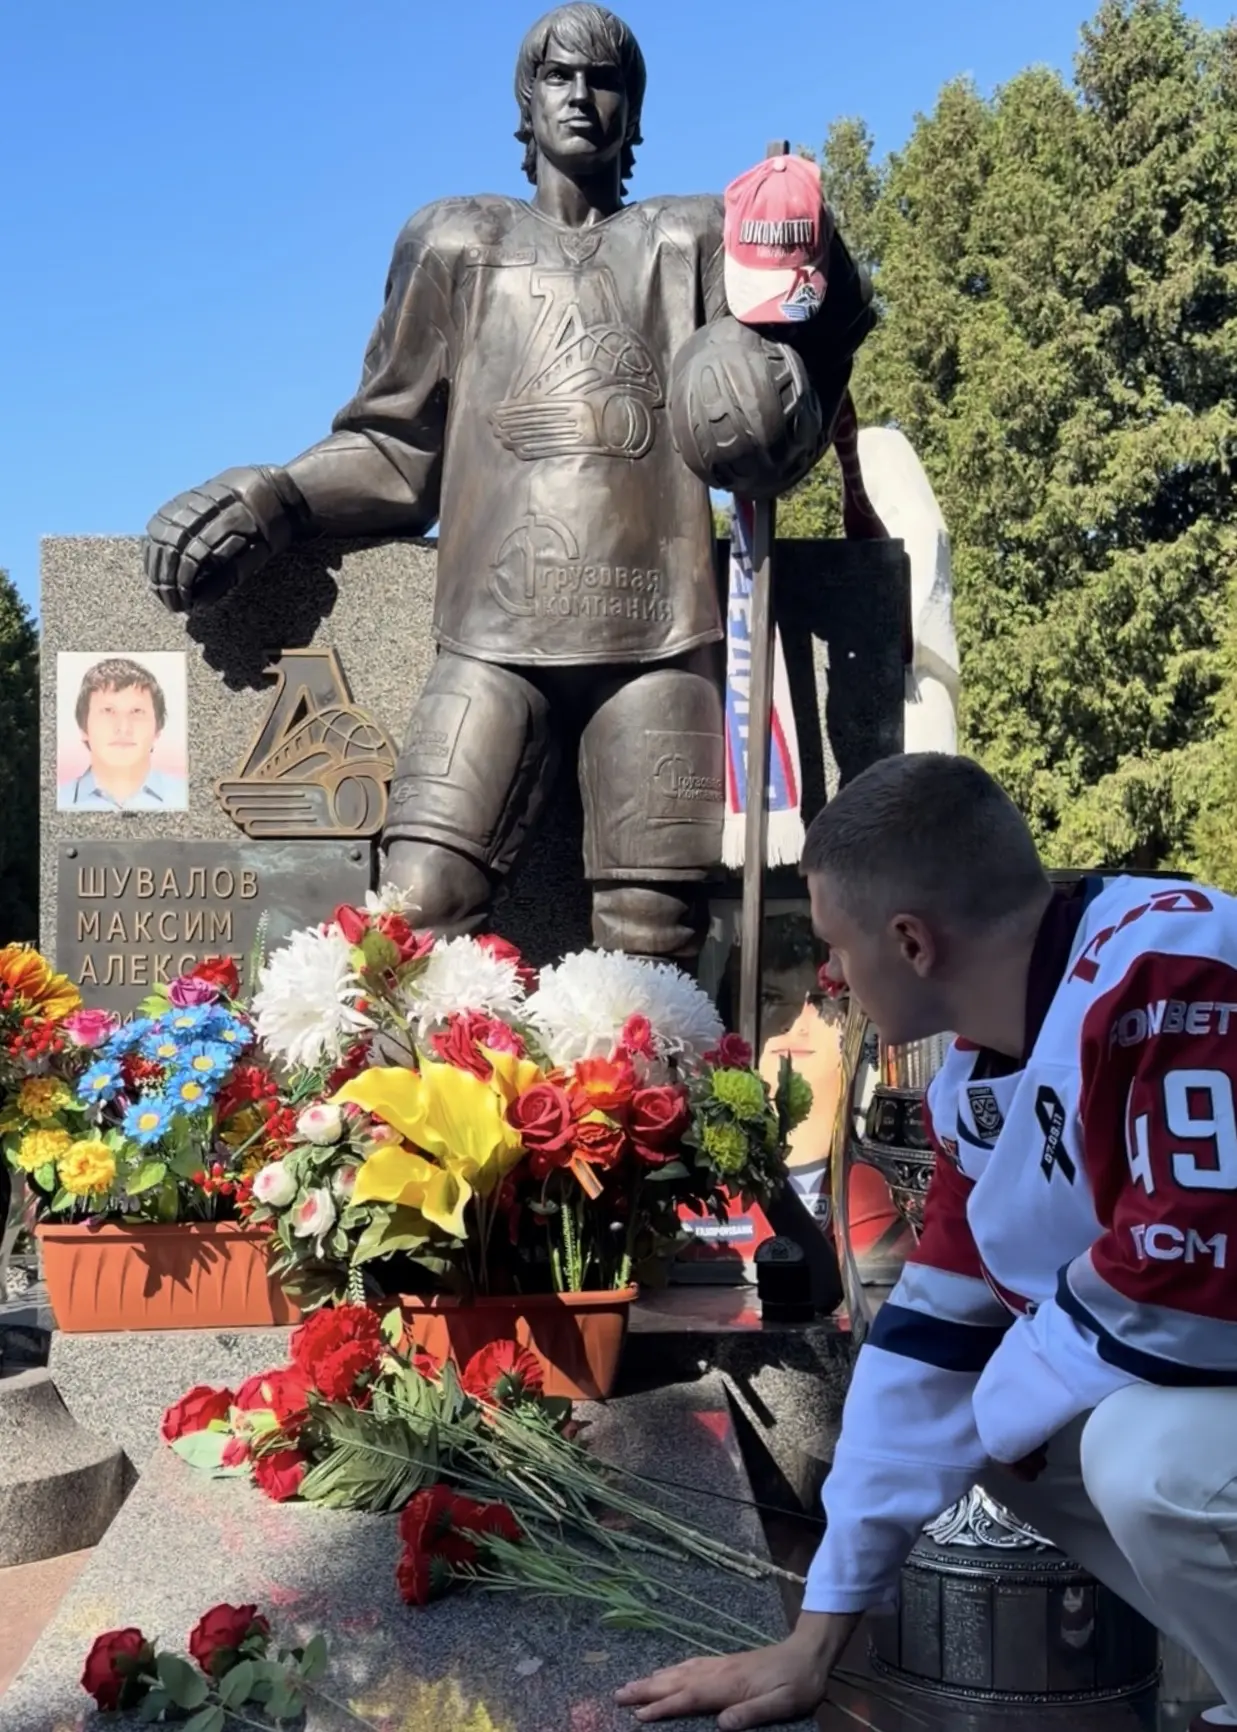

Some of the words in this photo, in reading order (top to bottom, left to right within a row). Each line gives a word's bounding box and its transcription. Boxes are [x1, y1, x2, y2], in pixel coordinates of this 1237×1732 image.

[541, 565, 662, 593] грузовая
[536, 594, 675, 622] компания
[77, 866, 259, 899] ШУВАЛОВ
[77, 911, 234, 943] МАКСИМ
[1044, 1112, 1064, 1164] 07.09.11
